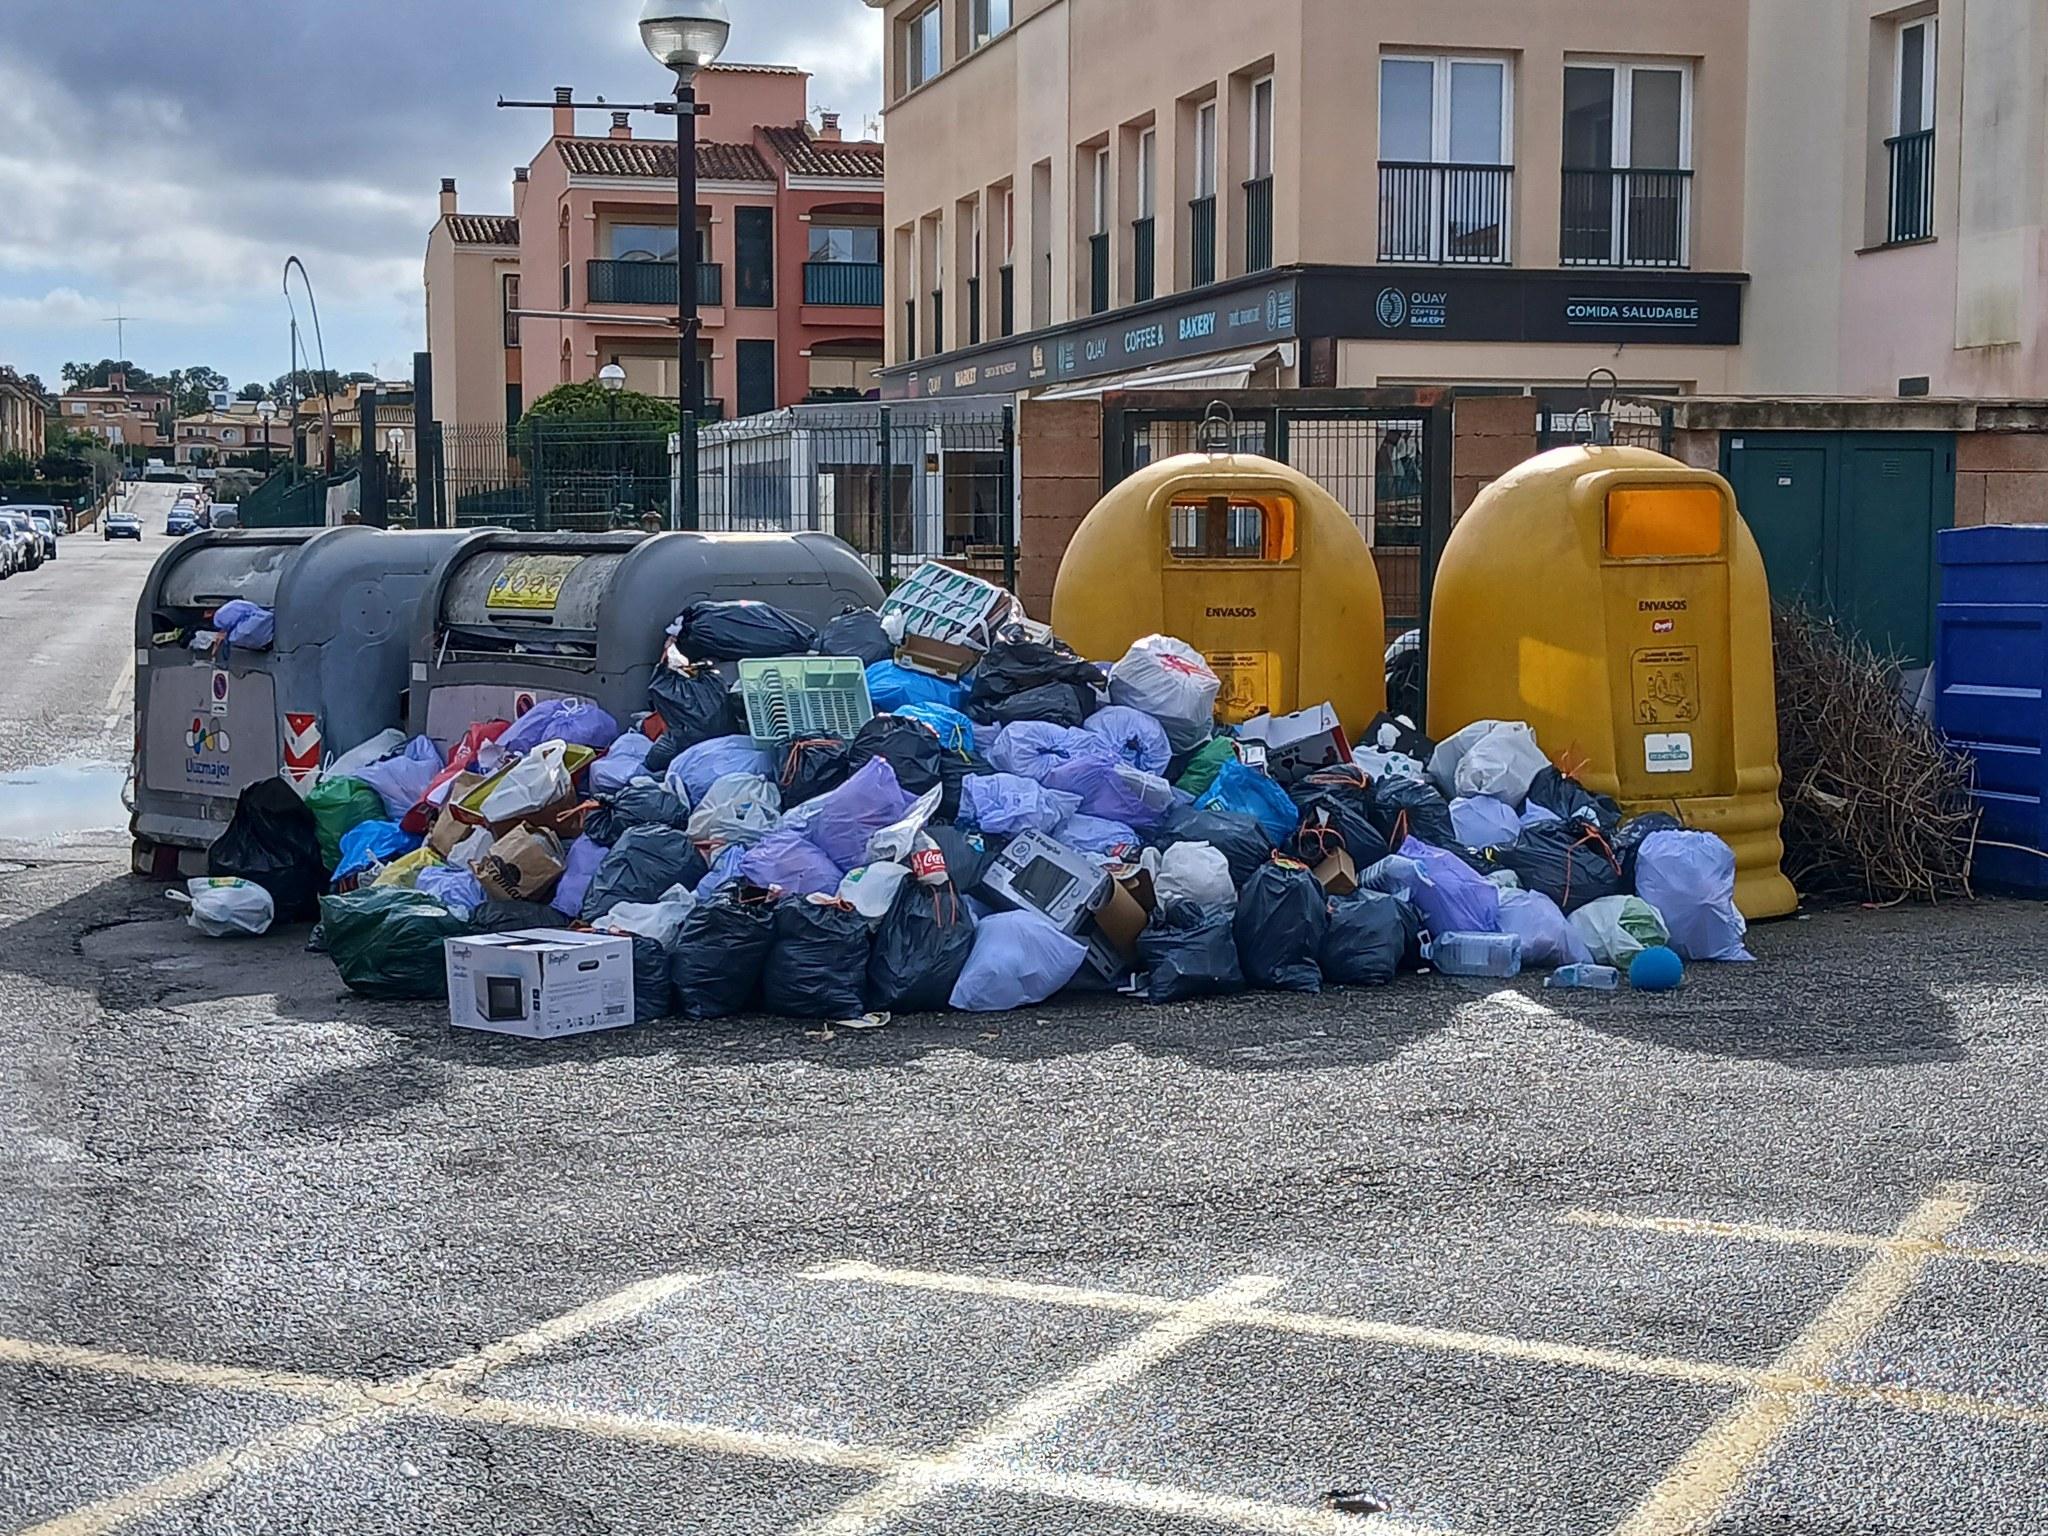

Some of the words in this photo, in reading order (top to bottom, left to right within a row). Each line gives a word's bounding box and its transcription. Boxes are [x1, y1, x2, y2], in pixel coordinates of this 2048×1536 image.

[1566, 305, 1619, 317] COMIDA
[1622, 306, 1699, 319] SALUDABLE
[1086, 338, 1108, 361] QUAY
[1124, 326, 1157, 353] COFFEE
[1179, 311, 1217, 340] BAKERY
[1638, 600, 1687, 611] ENVASOS
[1205, 607, 1257, 618] ENVASOS
